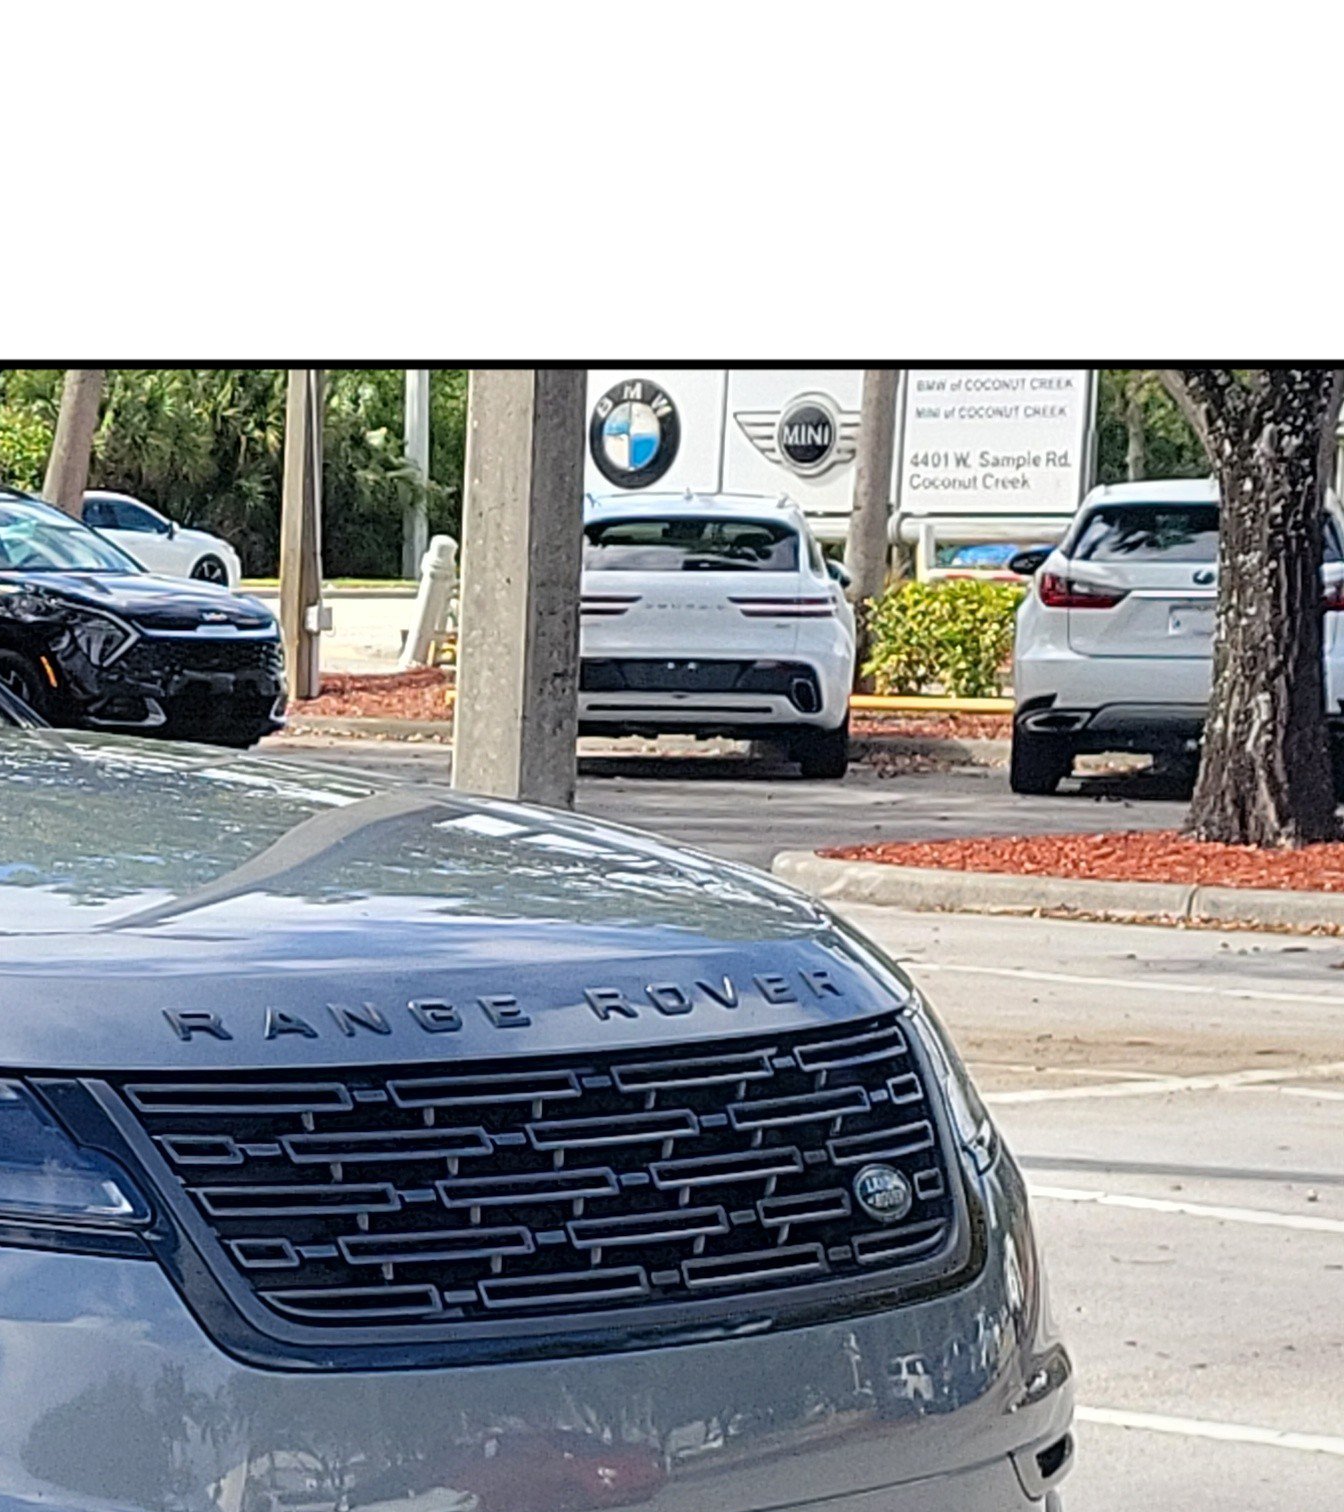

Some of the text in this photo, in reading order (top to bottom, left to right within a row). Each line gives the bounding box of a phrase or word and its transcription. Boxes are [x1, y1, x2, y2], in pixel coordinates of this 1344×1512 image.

[965, 377, 1026, 391] COCONUT
[596, 382, 673, 419] BMW
[958, 405, 1019, 419] COCONUT
[782, 424, 830, 446] MINI
[910, 451, 949, 468] 4401
[979, 450, 1042, 470] Sample
[909, 473, 1031, 491] Coconut Creek
[161, 967, 846, 1042] RANGE ROVER
